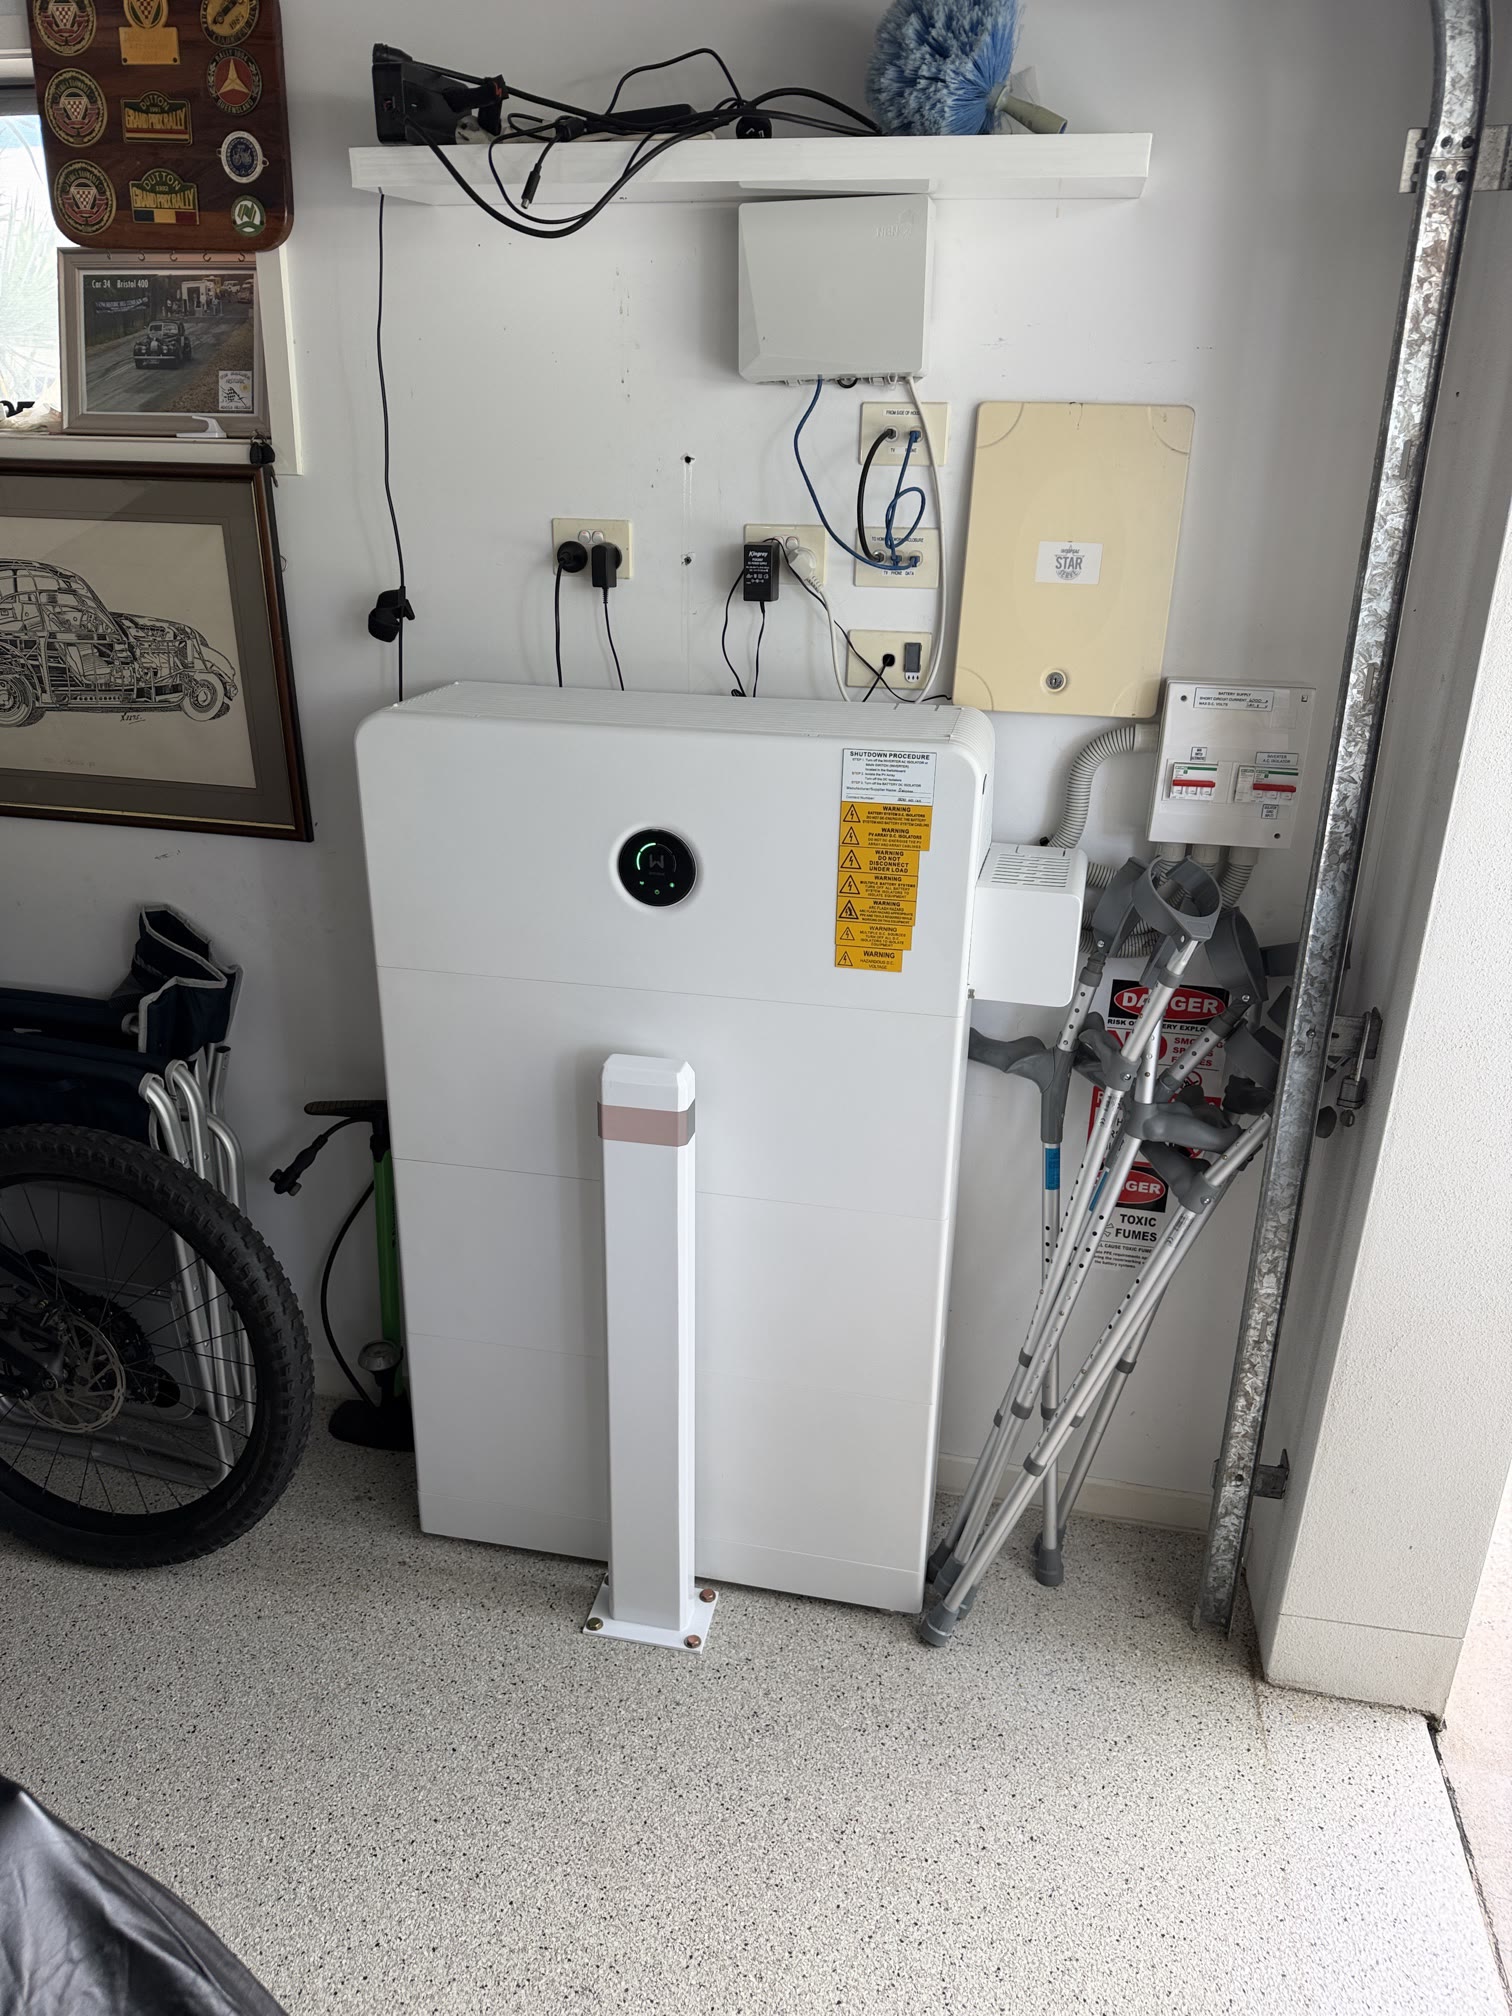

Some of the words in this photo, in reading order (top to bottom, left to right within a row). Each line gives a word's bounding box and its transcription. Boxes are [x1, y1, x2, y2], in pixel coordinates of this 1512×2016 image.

[140, 95, 170, 111] DUTTON
[217, 98, 254, 113] QUEENSLAND
[125, 107, 149, 129] GRAND
[165, 108, 186, 130] RALLY
[143, 172, 182, 190] DUTTON
[133, 186, 157, 208] GRAND
[172, 188, 194, 209] RALLY
[91, 279, 102, 288] Car
[103, 279, 111, 288] 34
[116, 279, 137, 288] Bristol
[137, 279, 149, 288] 400
[1055, 556, 1083, 570] STAR
[888, 752, 930, 760] PROCEDURE
[869, 860, 909, 868] DISCONNECT
[863, 950, 895, 959] WARNING
[1122, 992, 1218, 1014] DAGER
[1180, 1023, 1206, 1031] EXPLO
[1120, 1214, 1157, 1227] TOXIC
[1115, 1228, 1158, 1242] FUMES
